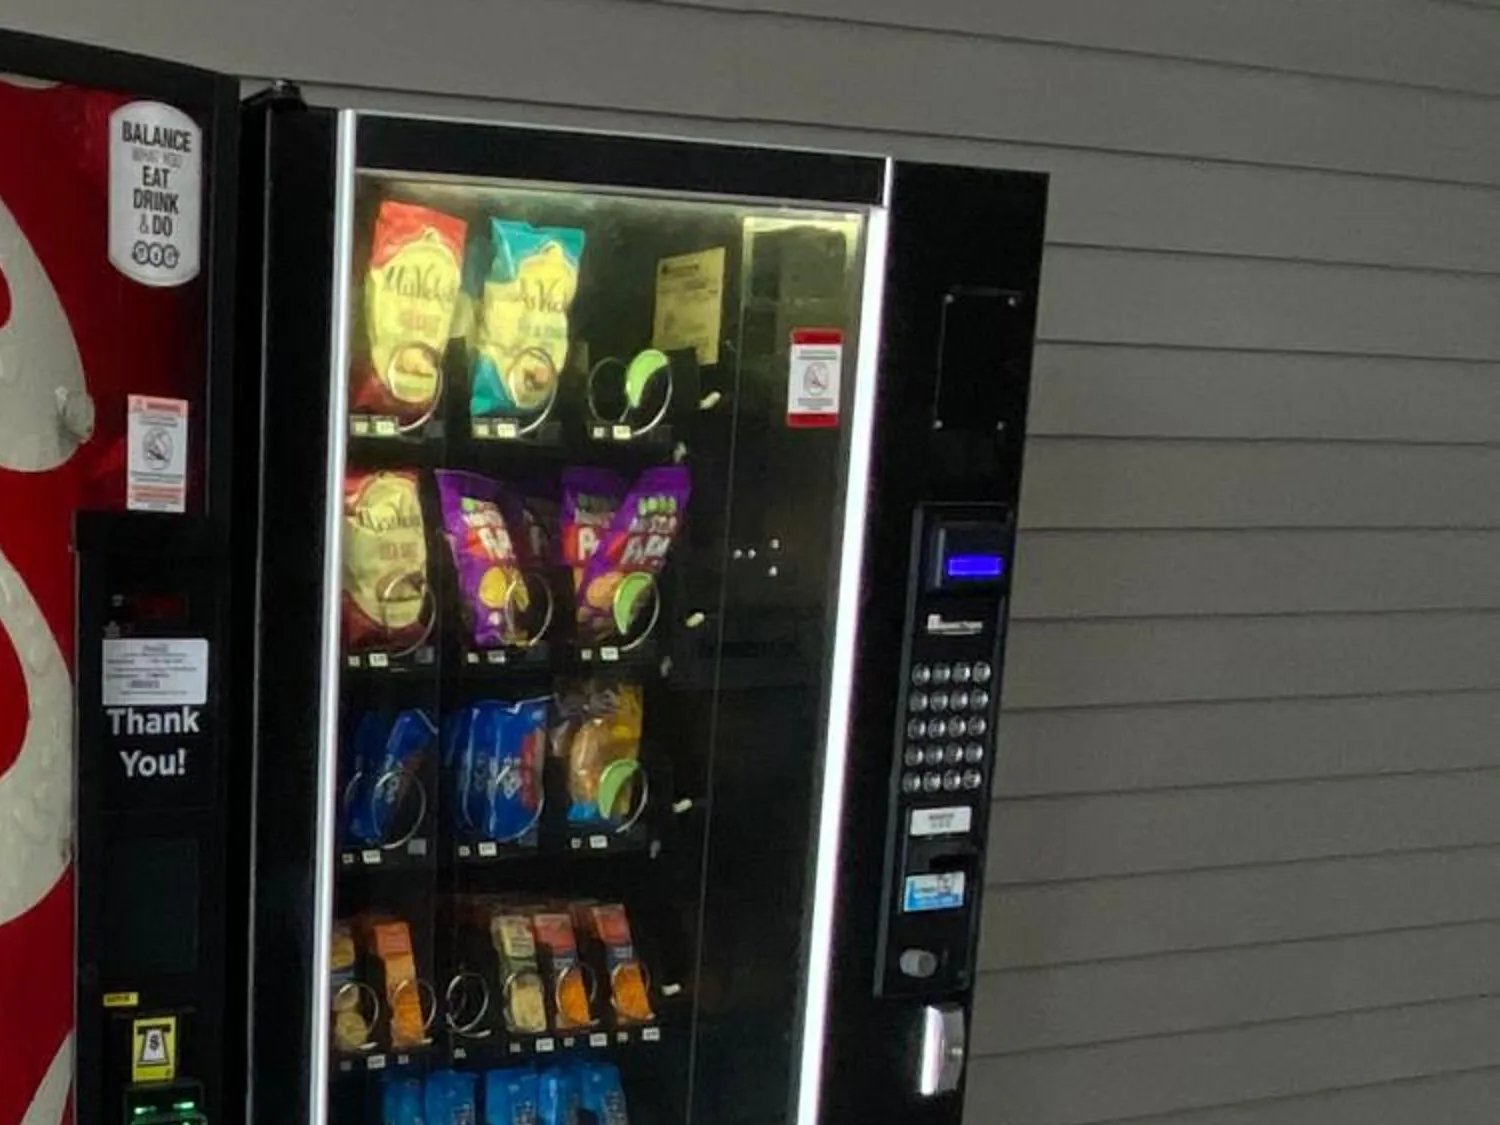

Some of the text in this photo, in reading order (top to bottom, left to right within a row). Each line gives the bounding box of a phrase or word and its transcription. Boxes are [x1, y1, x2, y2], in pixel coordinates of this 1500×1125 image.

[121, 120, 192, 152] BALANCE
[142, 165, 170, 187] EAT
[133, 188, 179, 214] DRINK
[152, 215, 173, 237] DO
[106, 706, 200, 735] Thank
[119, 747, 187, 777] You!
